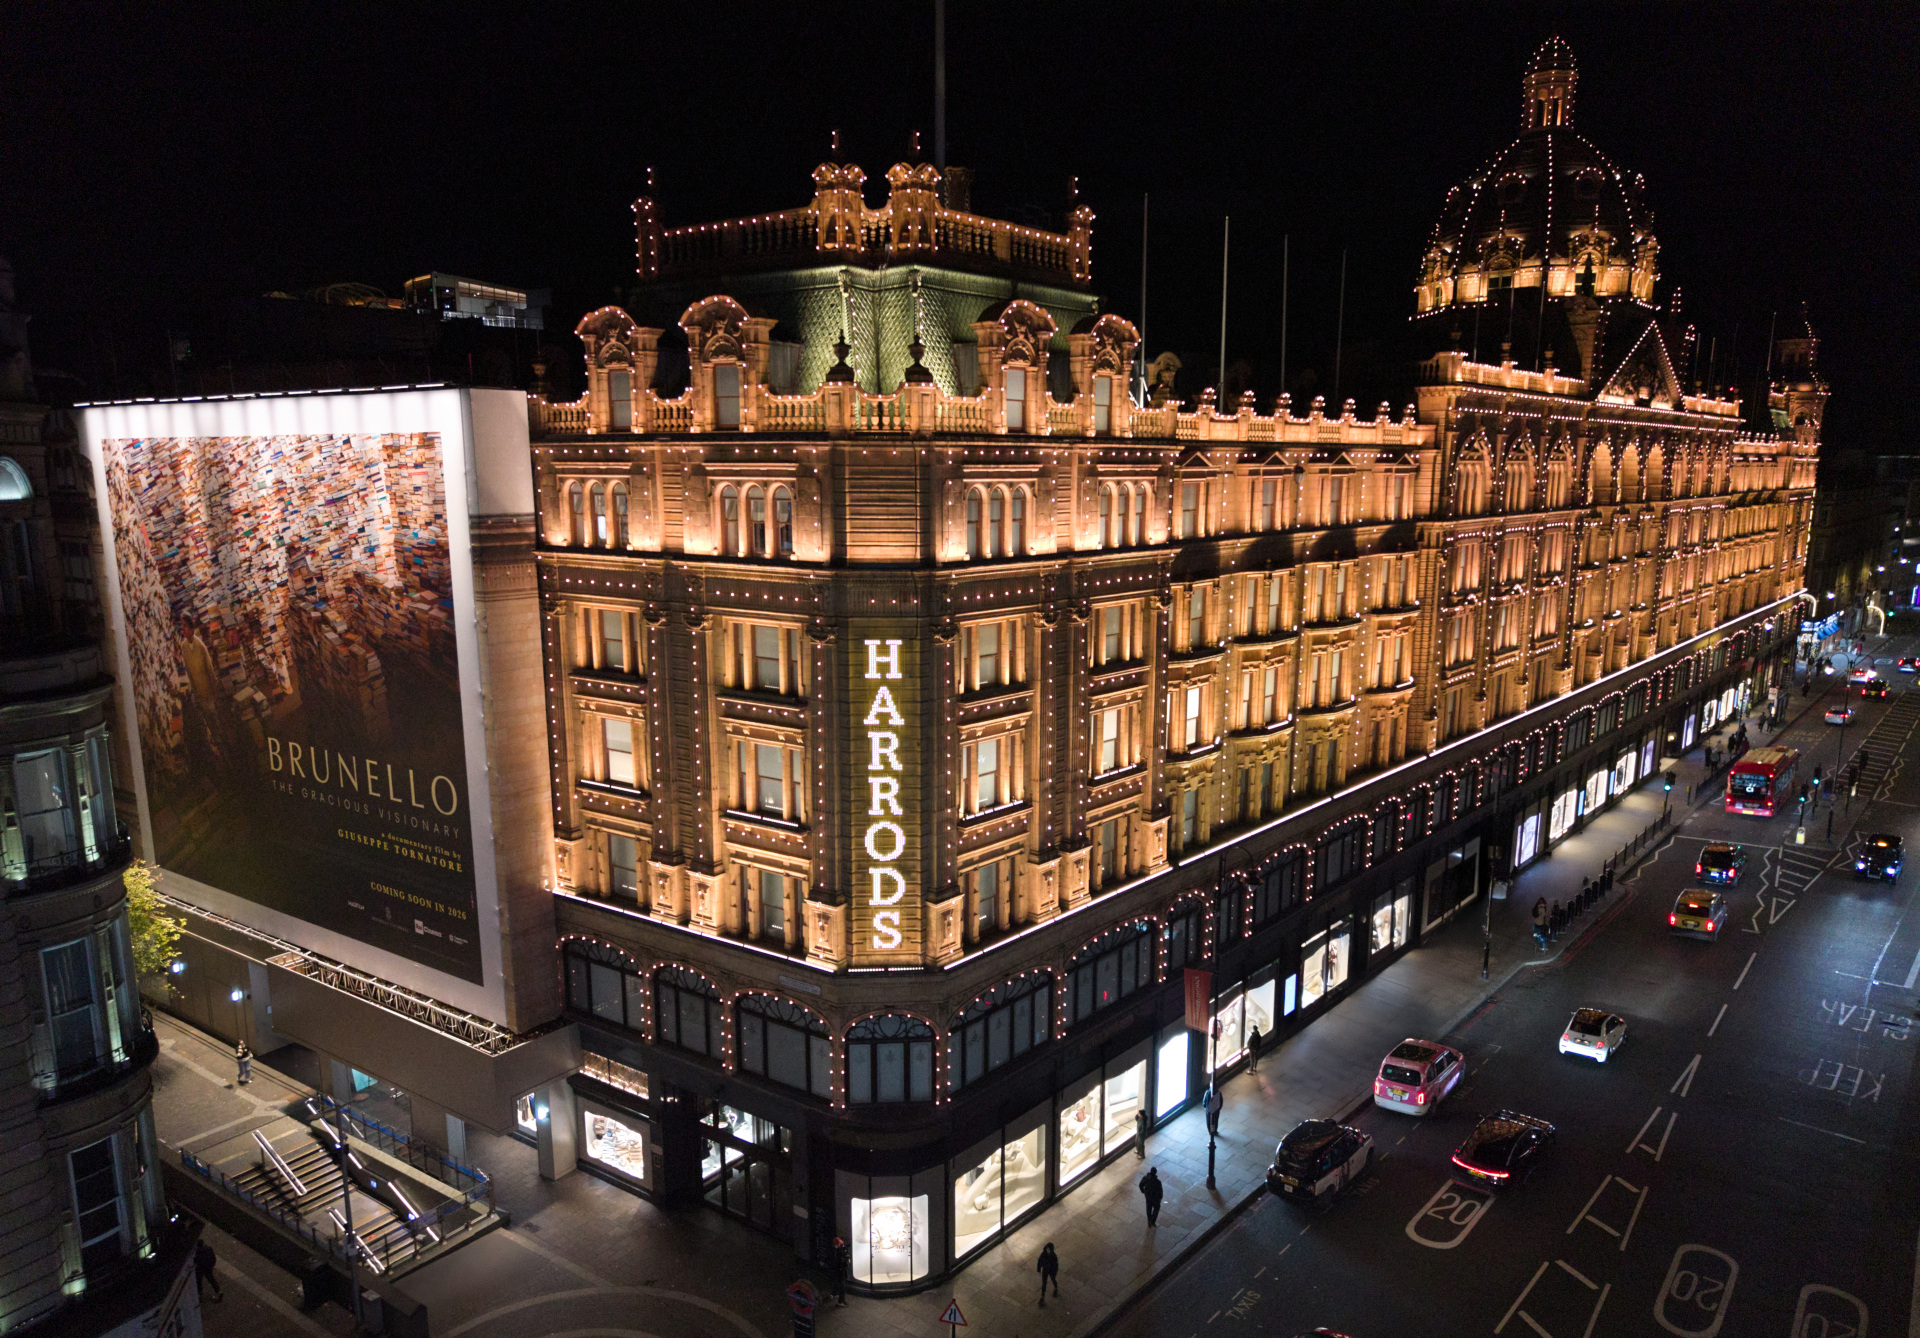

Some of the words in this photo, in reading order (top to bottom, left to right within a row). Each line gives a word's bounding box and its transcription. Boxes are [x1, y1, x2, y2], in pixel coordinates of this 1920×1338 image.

[267, 736, 458, 816] BRUNELLO
[864, 639, 905, 949] HARRODS
[272, 779, 294, 796] THE
[301, 787, 370, 816] GRACIOUS
[378, 807, 460, 840] VISIONARY
[337, 828, 390, 851] GIUSEPPE
[394, 844, 464, 873] TORNATORE
[387, 832, 432, 853] documentary
[434, 845, 450, 857] film
[452, 850, 462, 861] by
[370, 881, 406, 901] COMING
[407, 893, 433, 910] SOON
[434, 902, 445, 913] IN
[447, 906, 468, 921] 2026
[1799, 1059, 1886, 1102] KEEP
[1427, 1193, 1481, 1226] 20
[1225, 1289, 1262, 1320] TAXIS
[1671, 1270, 1725, 1311] 20
